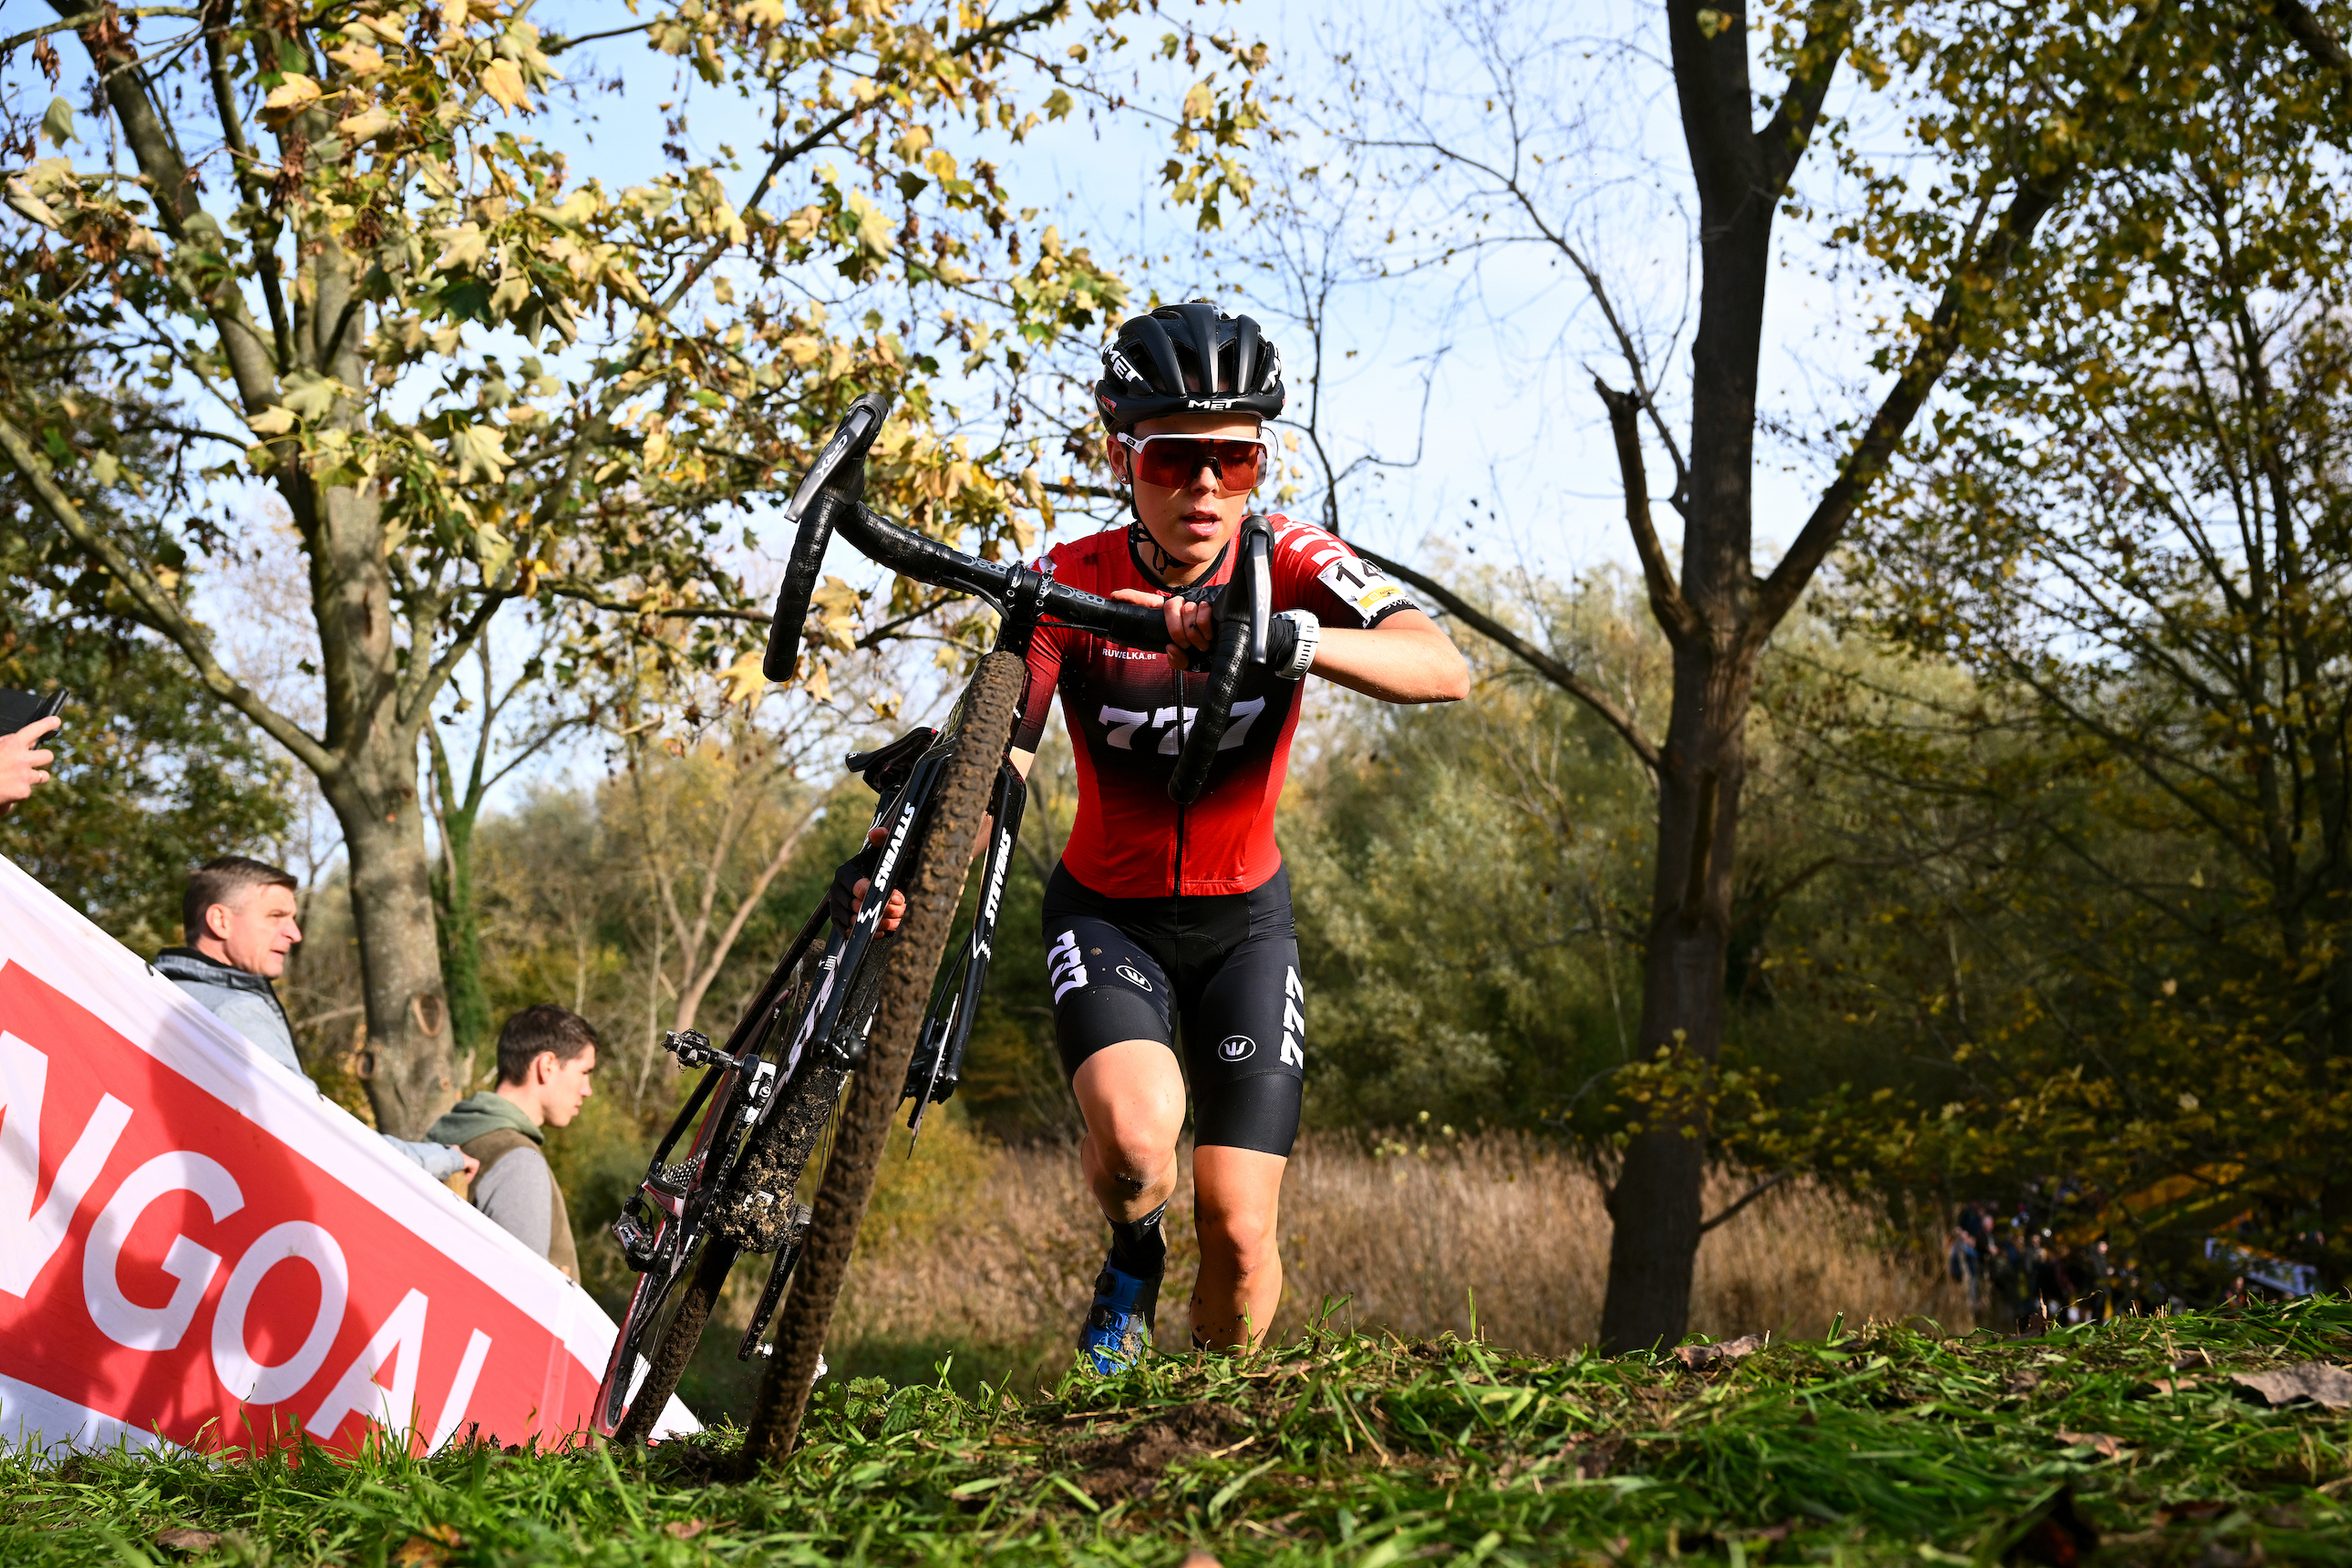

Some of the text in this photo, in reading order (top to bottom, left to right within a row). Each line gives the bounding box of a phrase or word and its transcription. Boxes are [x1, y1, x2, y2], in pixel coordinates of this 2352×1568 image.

[1104, 343, 1143, 382] MET
[1188, 400, 1237, 410] MET
[815, 434, 848, 478] GRX
[1058, 584, 1106, 605] Deda
[1102, 648, 1157, 660] RUWELKA.BE
[1099, 696, 1266, 756] 777
[874, 801, 915, 892] STEVENS
[985, 828, 1012, 927] STEVENS
[1047, 930, 1088, 1005] 777
[1280, 965, 1305, 1070] 777
